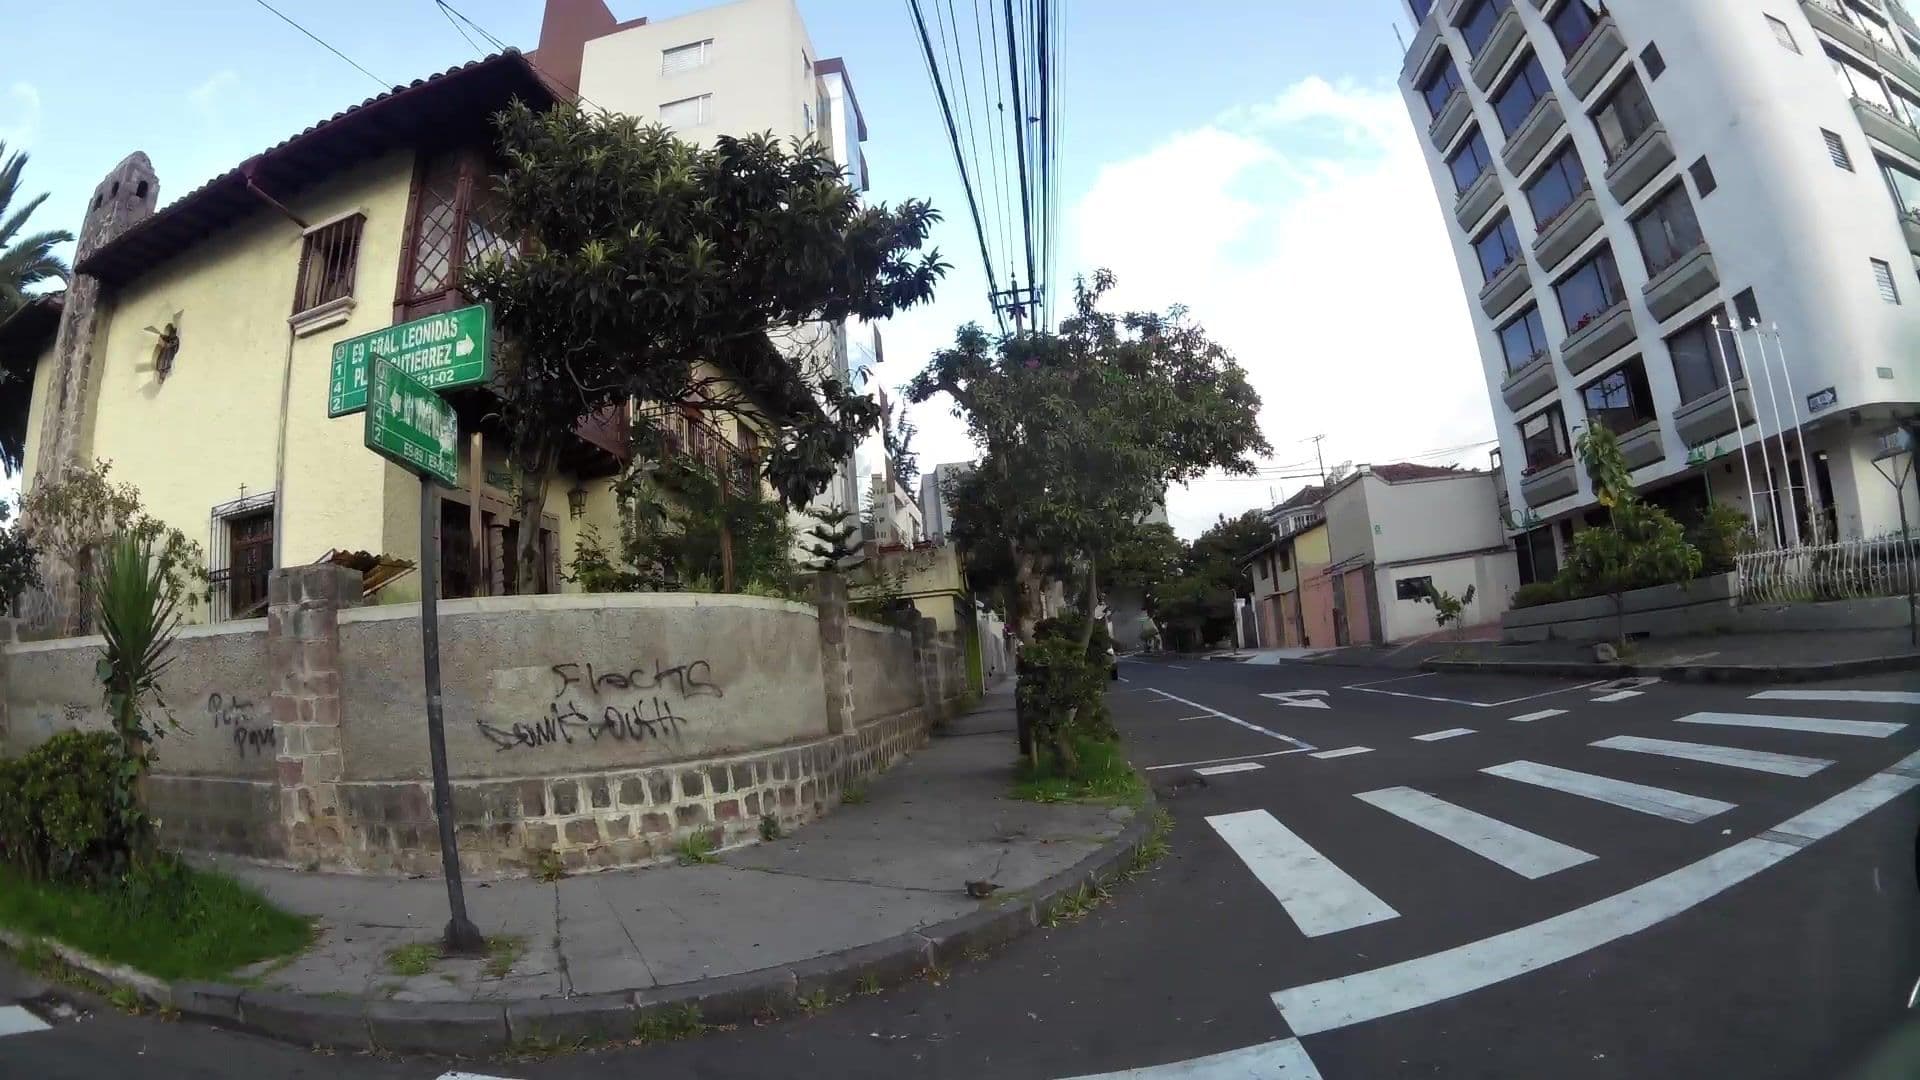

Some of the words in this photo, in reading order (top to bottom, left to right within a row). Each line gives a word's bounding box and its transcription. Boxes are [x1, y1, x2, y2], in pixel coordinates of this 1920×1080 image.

[352, 343, 365, 364] E9
[402, 317, 459, 350] LEONIDAS
[417, 369, 454, 386] 21-02
